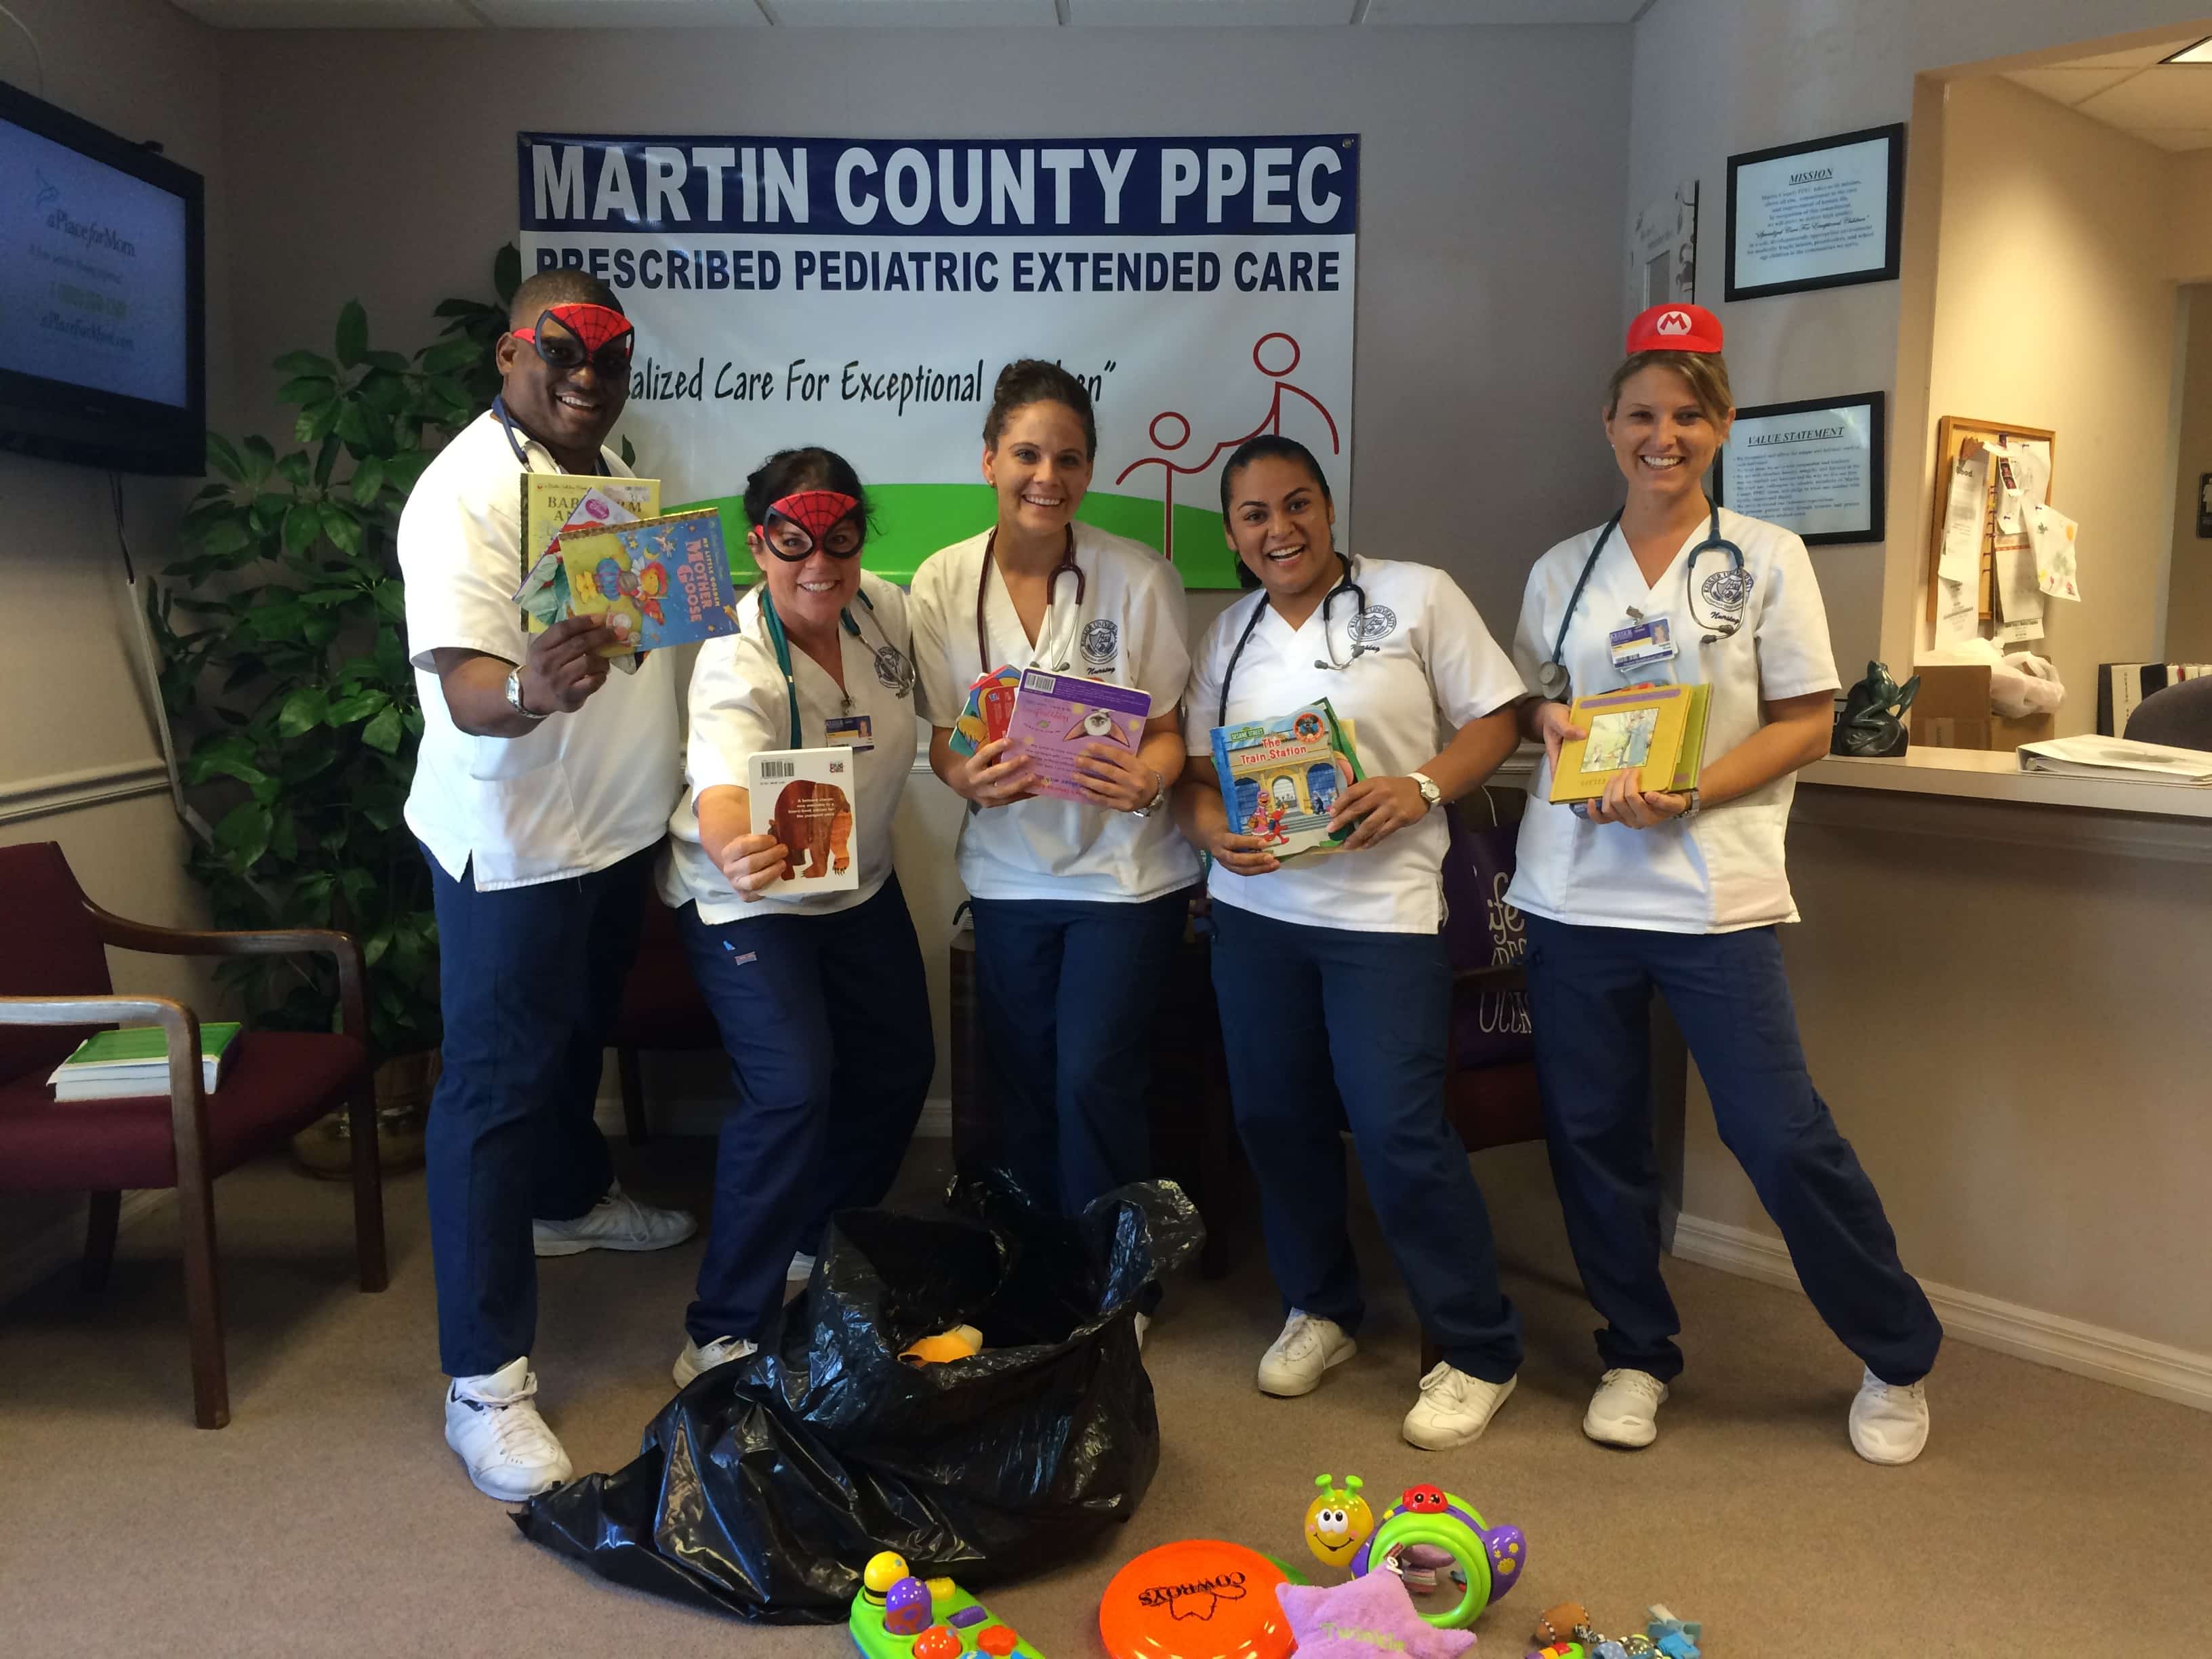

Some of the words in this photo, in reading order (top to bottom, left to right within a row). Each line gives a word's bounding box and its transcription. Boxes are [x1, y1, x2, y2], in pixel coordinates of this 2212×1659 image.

[532, 144, 810, 224] MARTIN
[835, 147, 1136, 226] COUNTY
[1161, 146, 1342, 224] PPEC
[1789, 168, 1833, 185] MISSION
[796, 251, 998, 292] PEDIATRIC
[1013, 252, 1221, 293] EXTENDED
[1235, 251, 1340, 292] CARE
[1660, 313, 1687, 330] M
[715, 361, 774, 401] Care
[787, 359, 830, 401] For
[842, 359, 983, 416] Exceptional
[1748, 434, 1782, 447] VALUE
[1783, 427, 1845, 444] STATEMENT
[685, 539, 712, 609] MOTHER
[677, 564, 702, 622] GOOSE
[1240, 754, 1266, 765] Train
[1269, 746, 1307, 760] Station
[1262, 738, 1280, 749] The
[1138, 1572, 1246, 1606] COWBOYS
[1319, 1622, 1406, 1654] Twinkle
